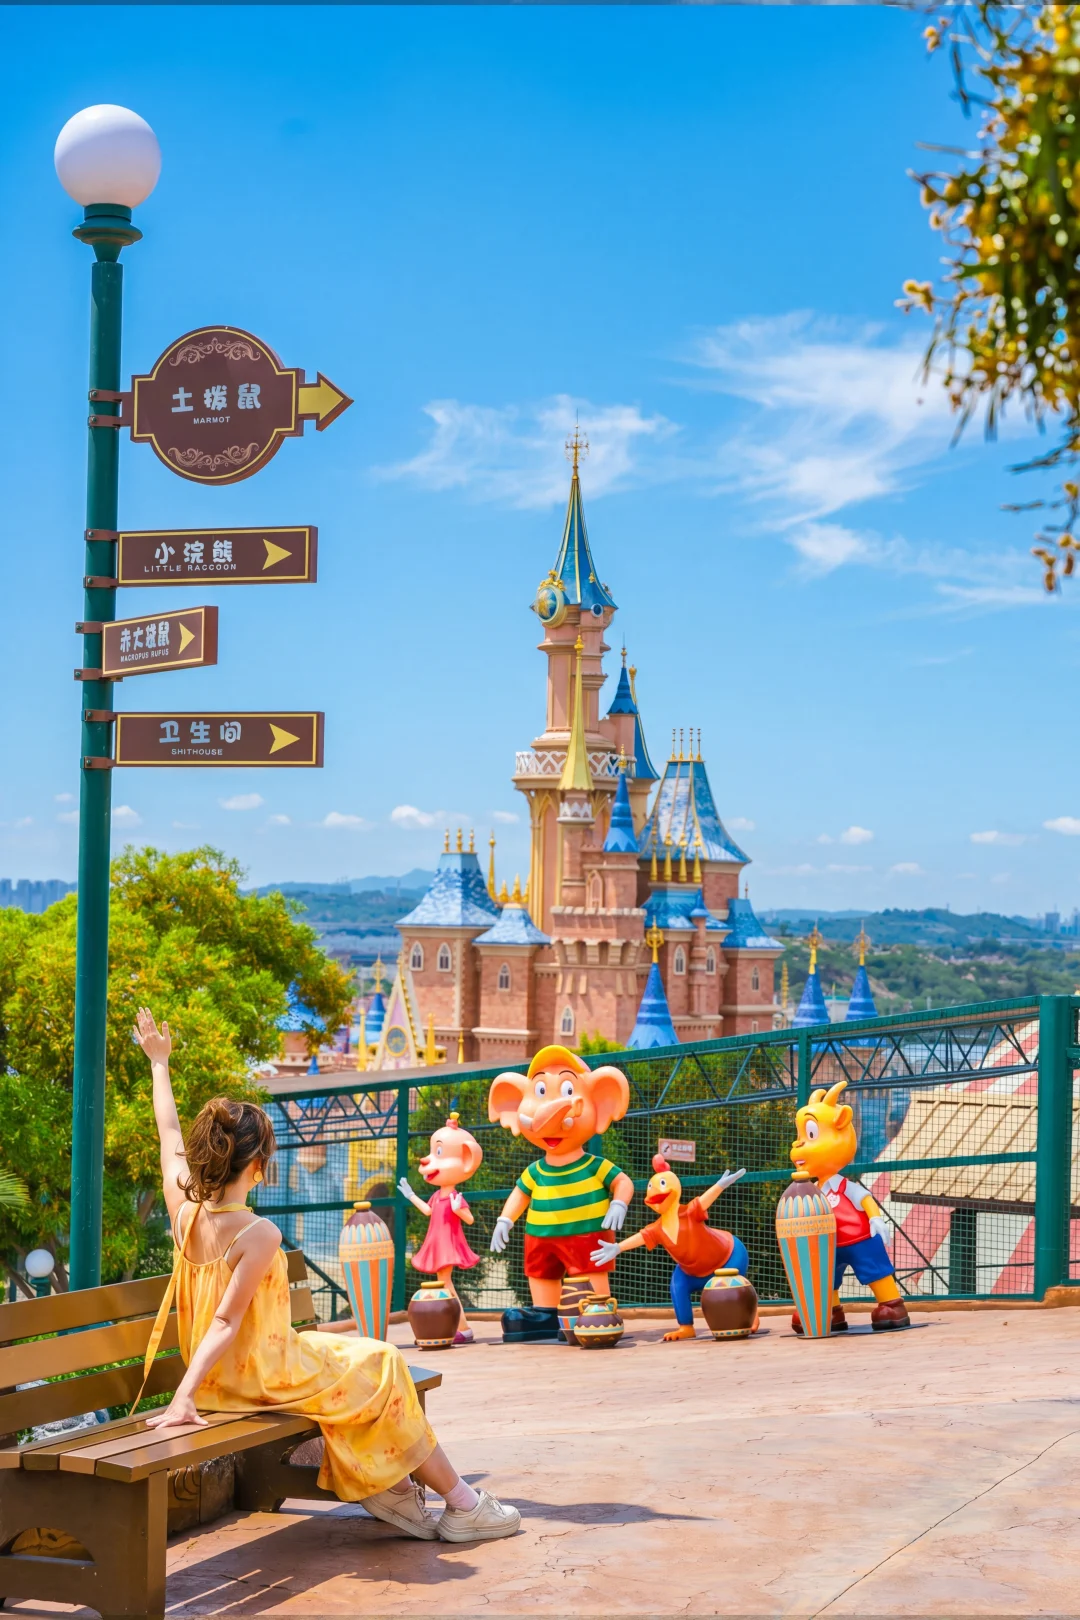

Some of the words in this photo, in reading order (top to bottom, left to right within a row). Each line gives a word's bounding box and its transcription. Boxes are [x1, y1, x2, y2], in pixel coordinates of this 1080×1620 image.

[171, 383, 262, 412] 土拨鼠
[193, 416, 231, 425] MARMOT
[154, 540, 233, 564] 小浣熊
[144, 564, 182, 573] LITTLE
[187, 563, 237, 572] RACCOON
[120, 621, 170, 653] 赤大袋鼠
[120, 651, 149, 662] MACROPUS
[150, 648, 170, 658] RUFUS
[159, 721, 242, 743] 卫生间
[171, 748, 223, 756] SHITHOUSE
